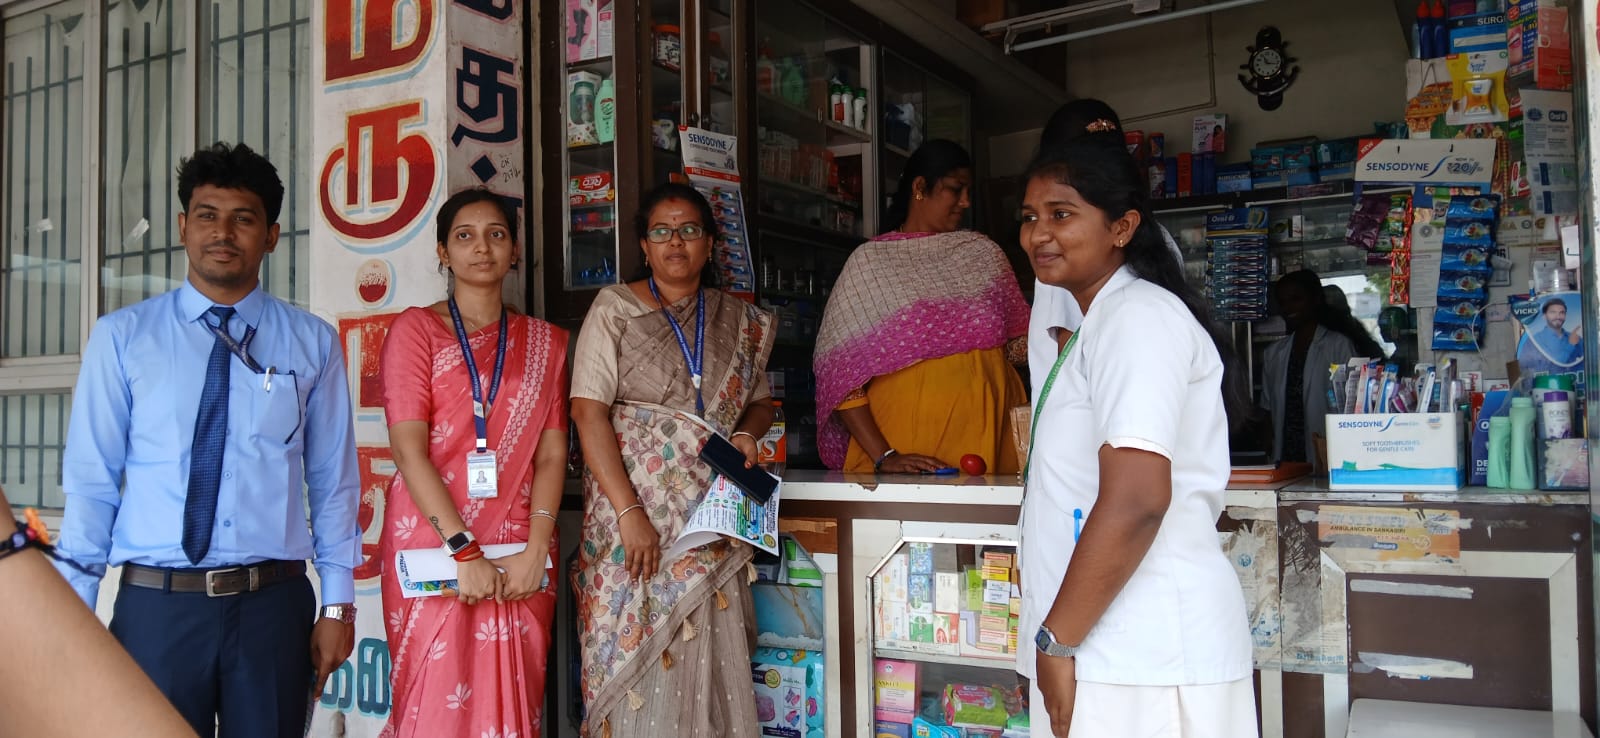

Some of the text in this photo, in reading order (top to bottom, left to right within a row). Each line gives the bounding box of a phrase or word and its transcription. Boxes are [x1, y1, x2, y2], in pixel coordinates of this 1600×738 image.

[688, 133, 727, 150] SENSODYNE
[1365, 162, 1430, 171] SENSODYNE
[1513, 307, 1539, 315] VICKS
[1338, 420, 1383, 429] SENSODYNE
